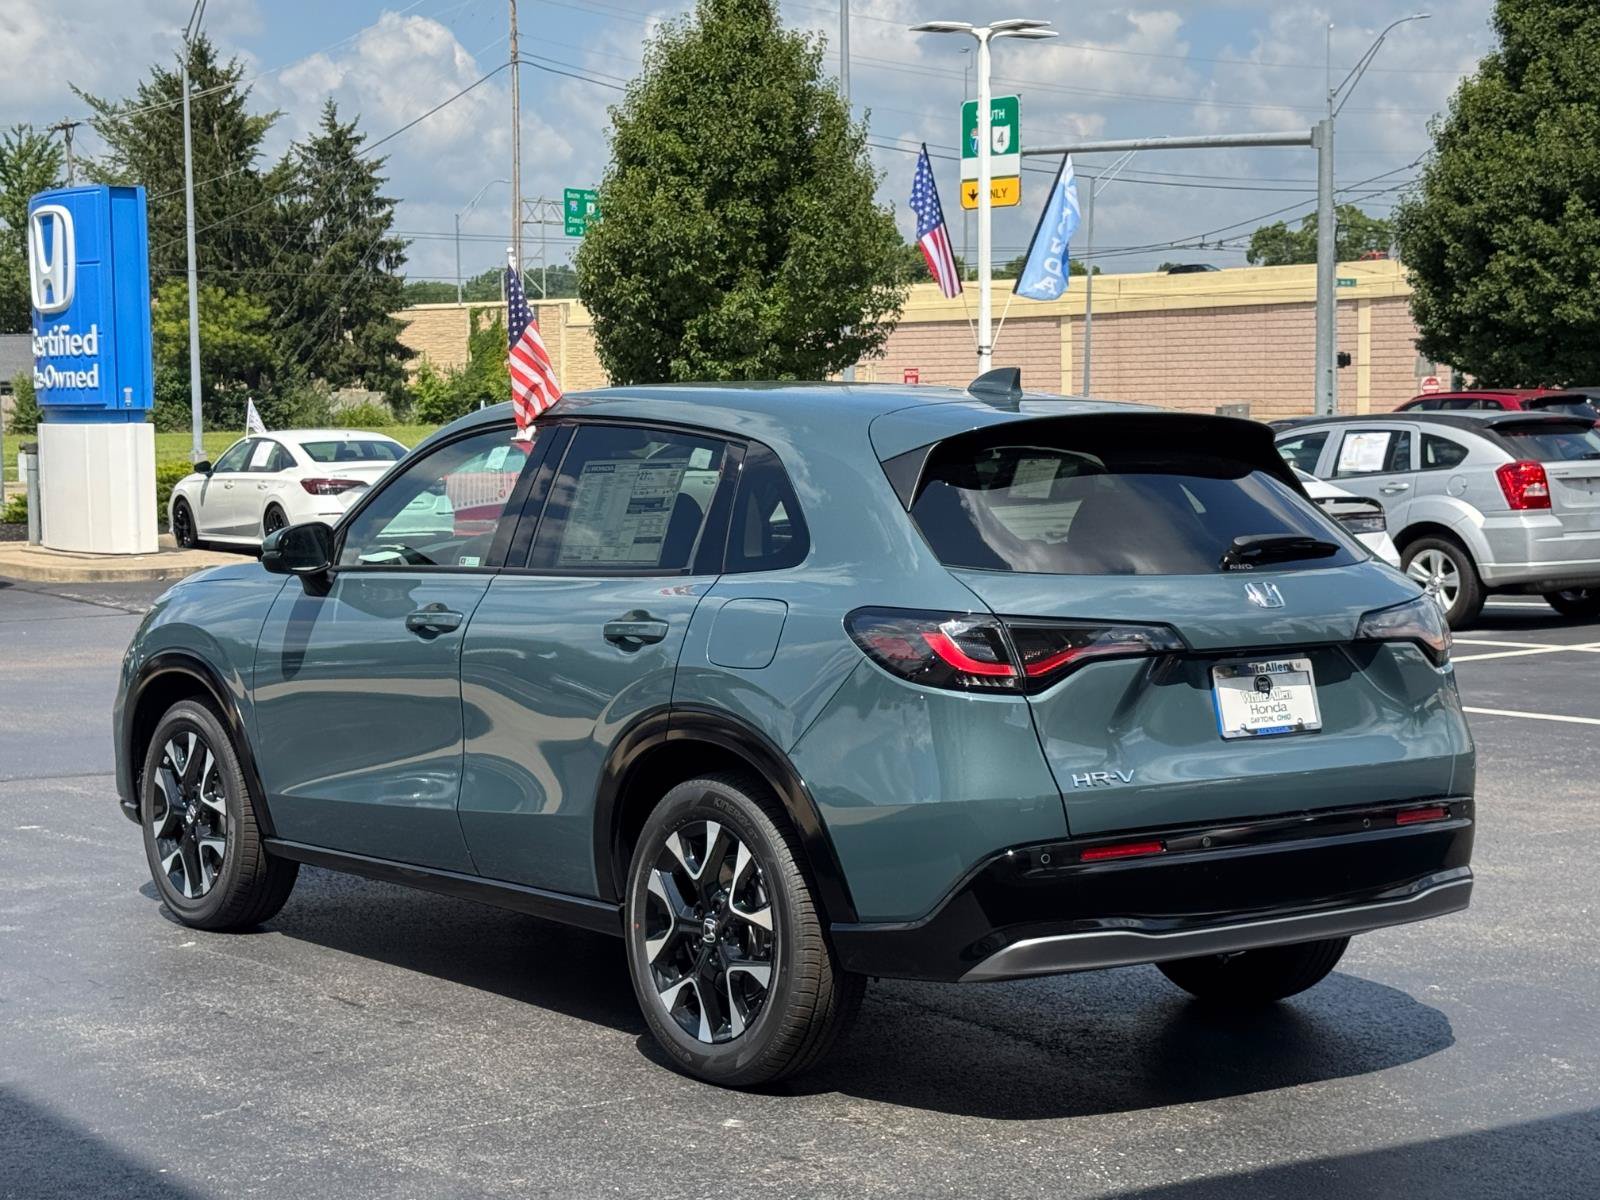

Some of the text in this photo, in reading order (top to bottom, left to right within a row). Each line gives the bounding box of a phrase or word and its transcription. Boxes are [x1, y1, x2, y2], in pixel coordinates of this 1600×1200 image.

[976, 109, 1005, 122] SUTH
[997, 132, 1004, 147] 4
[990, 188, 1008, 200] NLY
[1250, 702, 1287, 715] Honda
[1276, 713, 1292, 721] OHIO
[1071, 769, 1134, 788] HR-V
